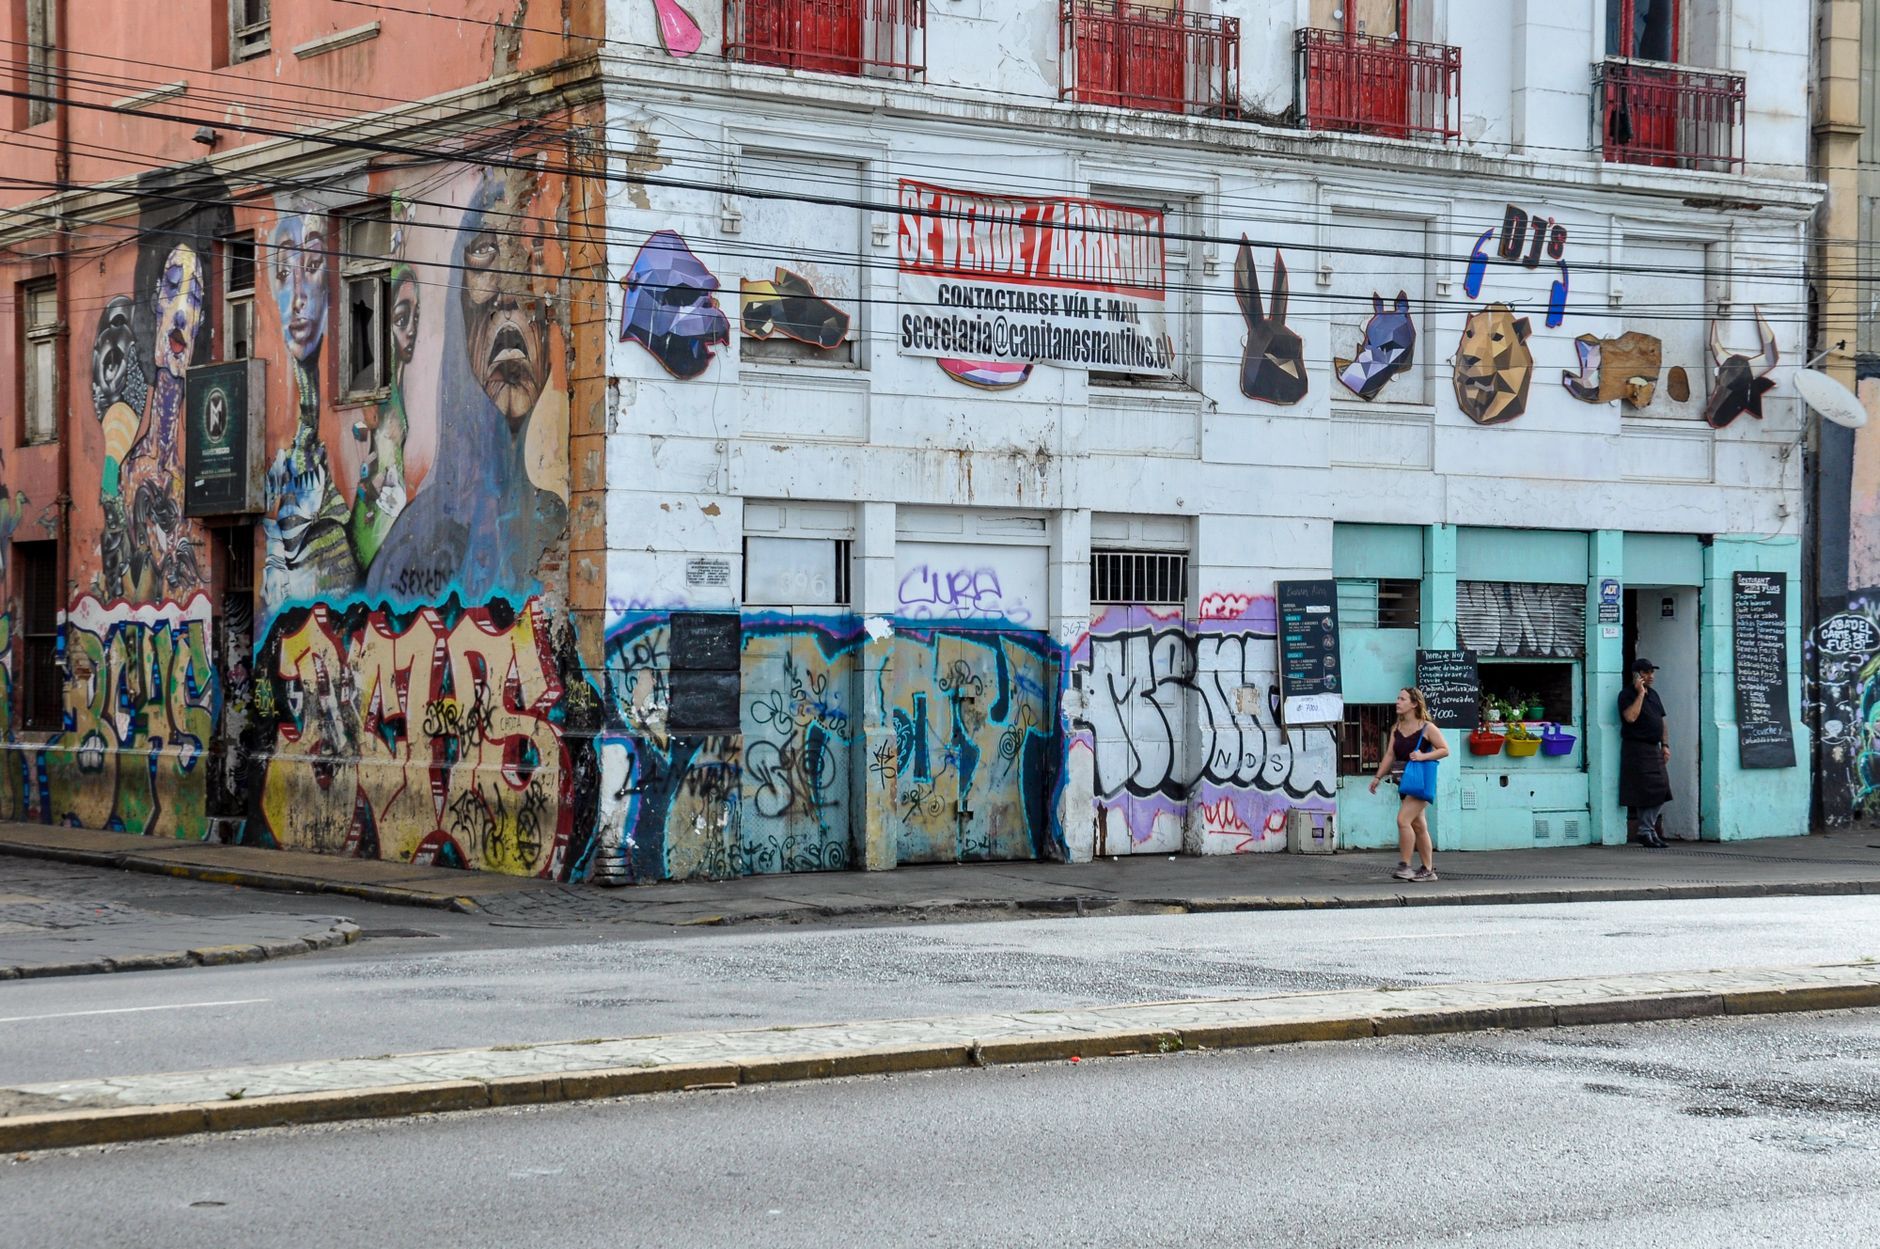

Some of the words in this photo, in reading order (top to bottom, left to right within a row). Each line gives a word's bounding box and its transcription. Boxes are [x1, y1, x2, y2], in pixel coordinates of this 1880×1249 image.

[901, 184, 935, 267] SE
[939, 193, 1027, 277] VENDE
[1048, 201, 1165, 291] ARRIENDA
[937, 283, 1059, 317] CONTACTARSE
[1063, 292, 1089, 319] VÍA
[1093, 299, 1141, 325] E-MAIL
[901, 313, 1172, 371] secretaria@capitanesnautilus.cl
[1604, 584, 1618, 595] ADT
